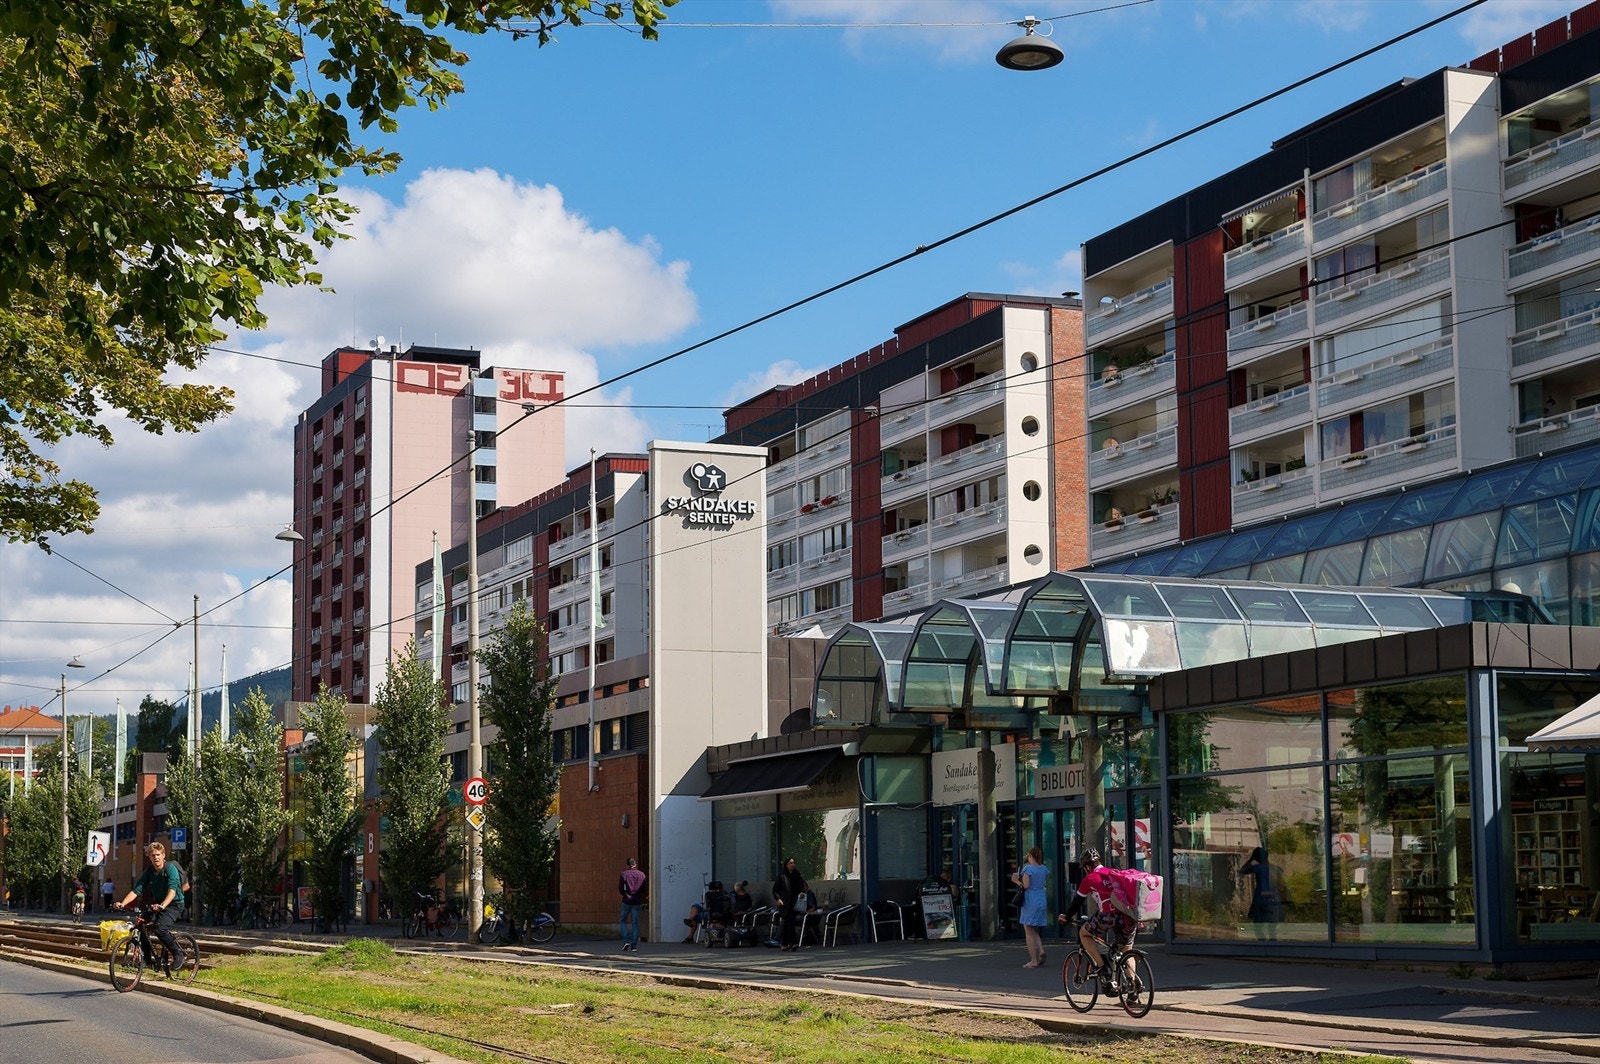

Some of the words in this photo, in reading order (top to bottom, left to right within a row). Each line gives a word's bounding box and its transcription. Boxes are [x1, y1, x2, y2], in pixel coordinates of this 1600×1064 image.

[667, 496, 758, 514] SANDAKER
[689, 512, 738, 525] SENTER
[1058, 715, 1076, 740] A
[945, 762, 979, 779] Sandake
[468, 784, 486, 798] 40
[175, 830, 183, 841] P
[368, 832, 374, 854] B
